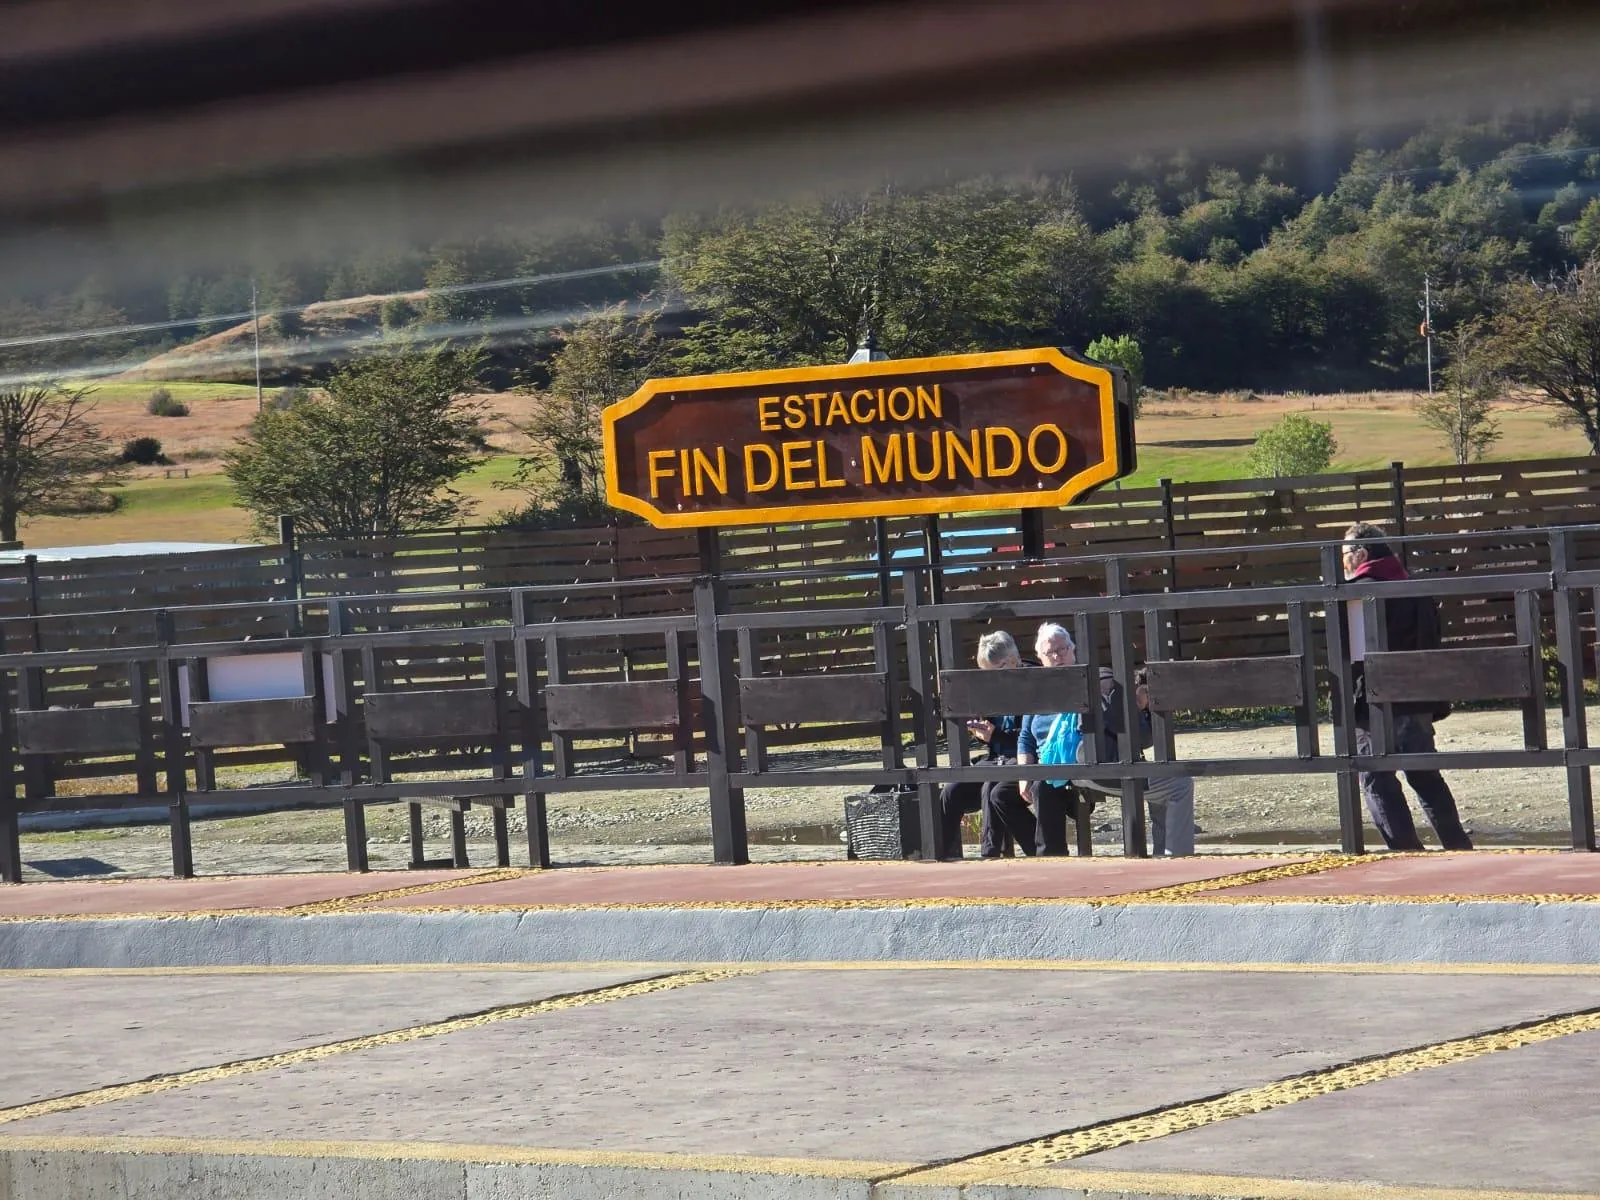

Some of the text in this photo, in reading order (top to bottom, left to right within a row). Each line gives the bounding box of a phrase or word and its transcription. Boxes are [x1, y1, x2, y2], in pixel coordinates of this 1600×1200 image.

[758, 384, 942, 432] ESTACION
[648, 423, 1068, 499] FIN DEL MUNDO
